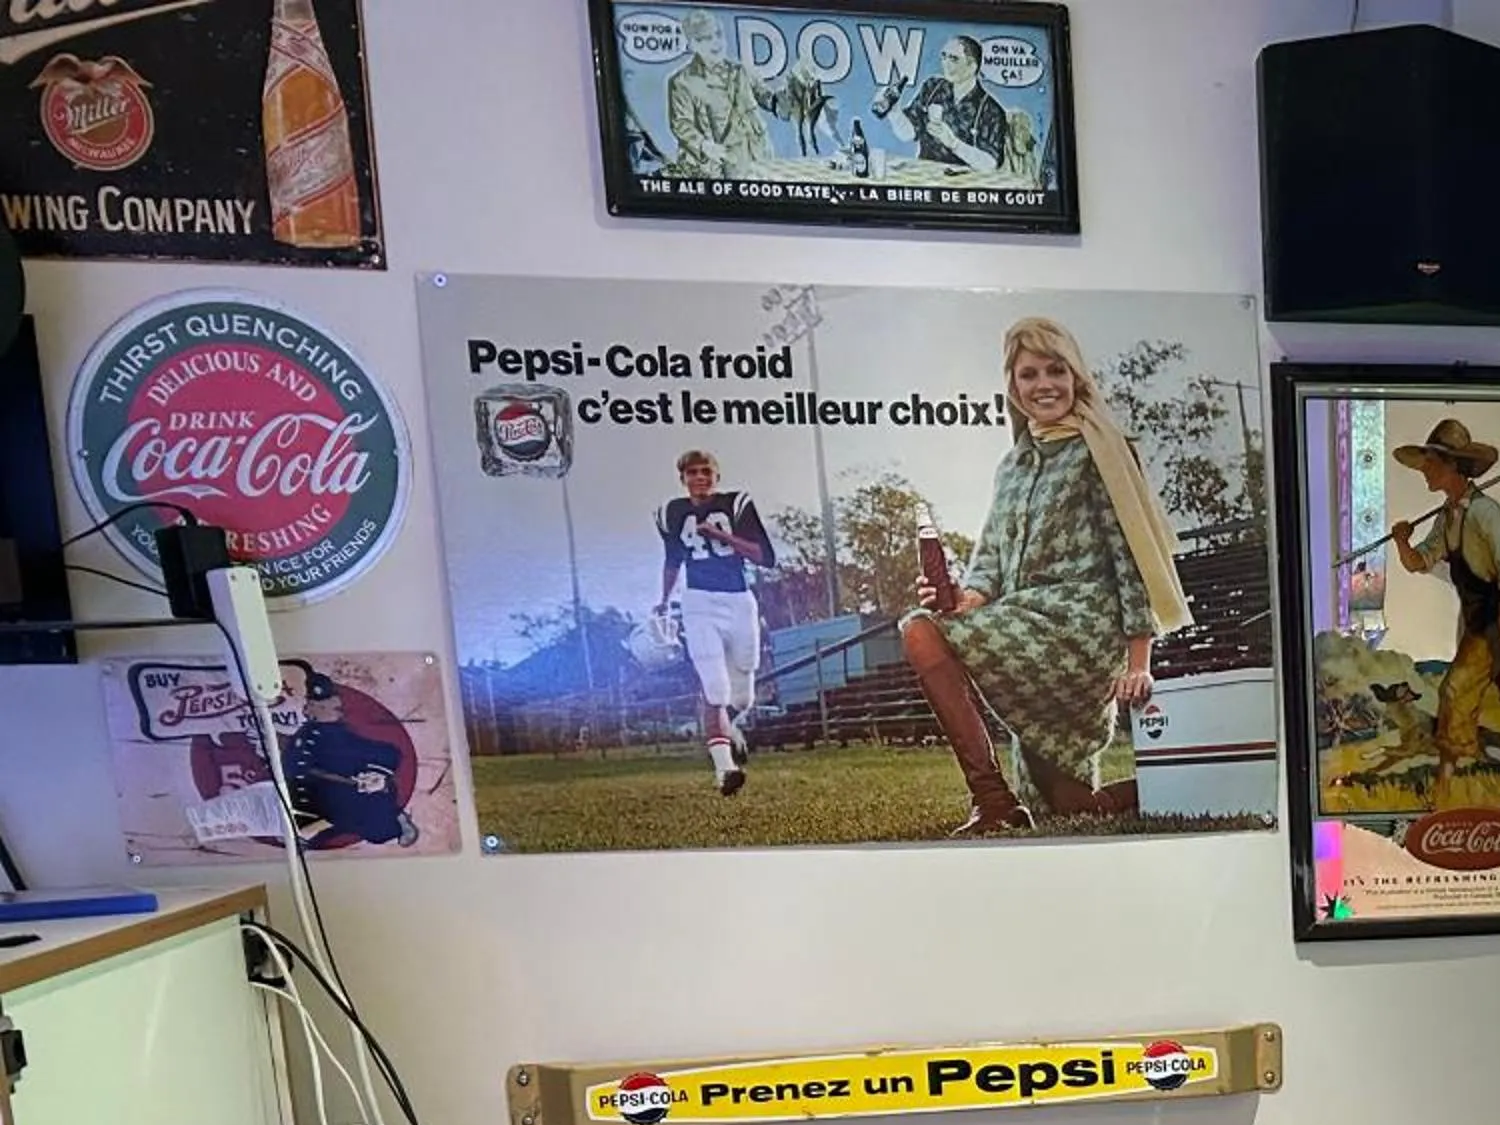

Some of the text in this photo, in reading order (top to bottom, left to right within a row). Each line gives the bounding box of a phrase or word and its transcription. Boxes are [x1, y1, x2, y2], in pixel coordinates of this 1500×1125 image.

[633, 36, 680, 52] DOW!
[734, 16, 927, 88] DOW
[992, 45, 1026, 55] ON VA
[984, 56, 1039, 67] MOUILLER
[1001, 68, 1024, 84] ÇA!
[640, 180, 671, 193] THE
[678, 181, 705, 195] ALE
[712, 182, 733, 195] OF
[738, 183, 782, 197] GOOD
[786, 184, 830, 199] TASTE
[859, 188, 879, 200] LA
[940, 190, 960, 203] DE
[967, 191, 999, 204] BON
[2, 185, 255, 235] WING COMPANY
[99, 313, 362, 405] THIRST QUENCHING
[468, 340, 793, 381] Pepsi-Cola froid
[147, 350, 318, 407] DELICIOUS AND
[169, 411, 256, 431] DRINK
[577, 390, 1007, 427] c'est le meilleur choix!
[680, 510, 735, 560] 40
[274, 555, 301, 574] ICE
[303, 539, 335, 567] FOR
[280, 519, 377, 590] YOUR FRIENDS
[145, 673, 180, 688] BUY
[237, 710, 298, 728] TOAY!
[1140, 716, 1168, 728] PEPSI
[1373, 877, 1398, 886] THE
[1405, 873, 1498, 885] REFRESHING
[700, 1078, 850, 1106] Prenez
[863, 1073, 914, 1096] un
[926, 1051, 1115, 1098] Pepsi
